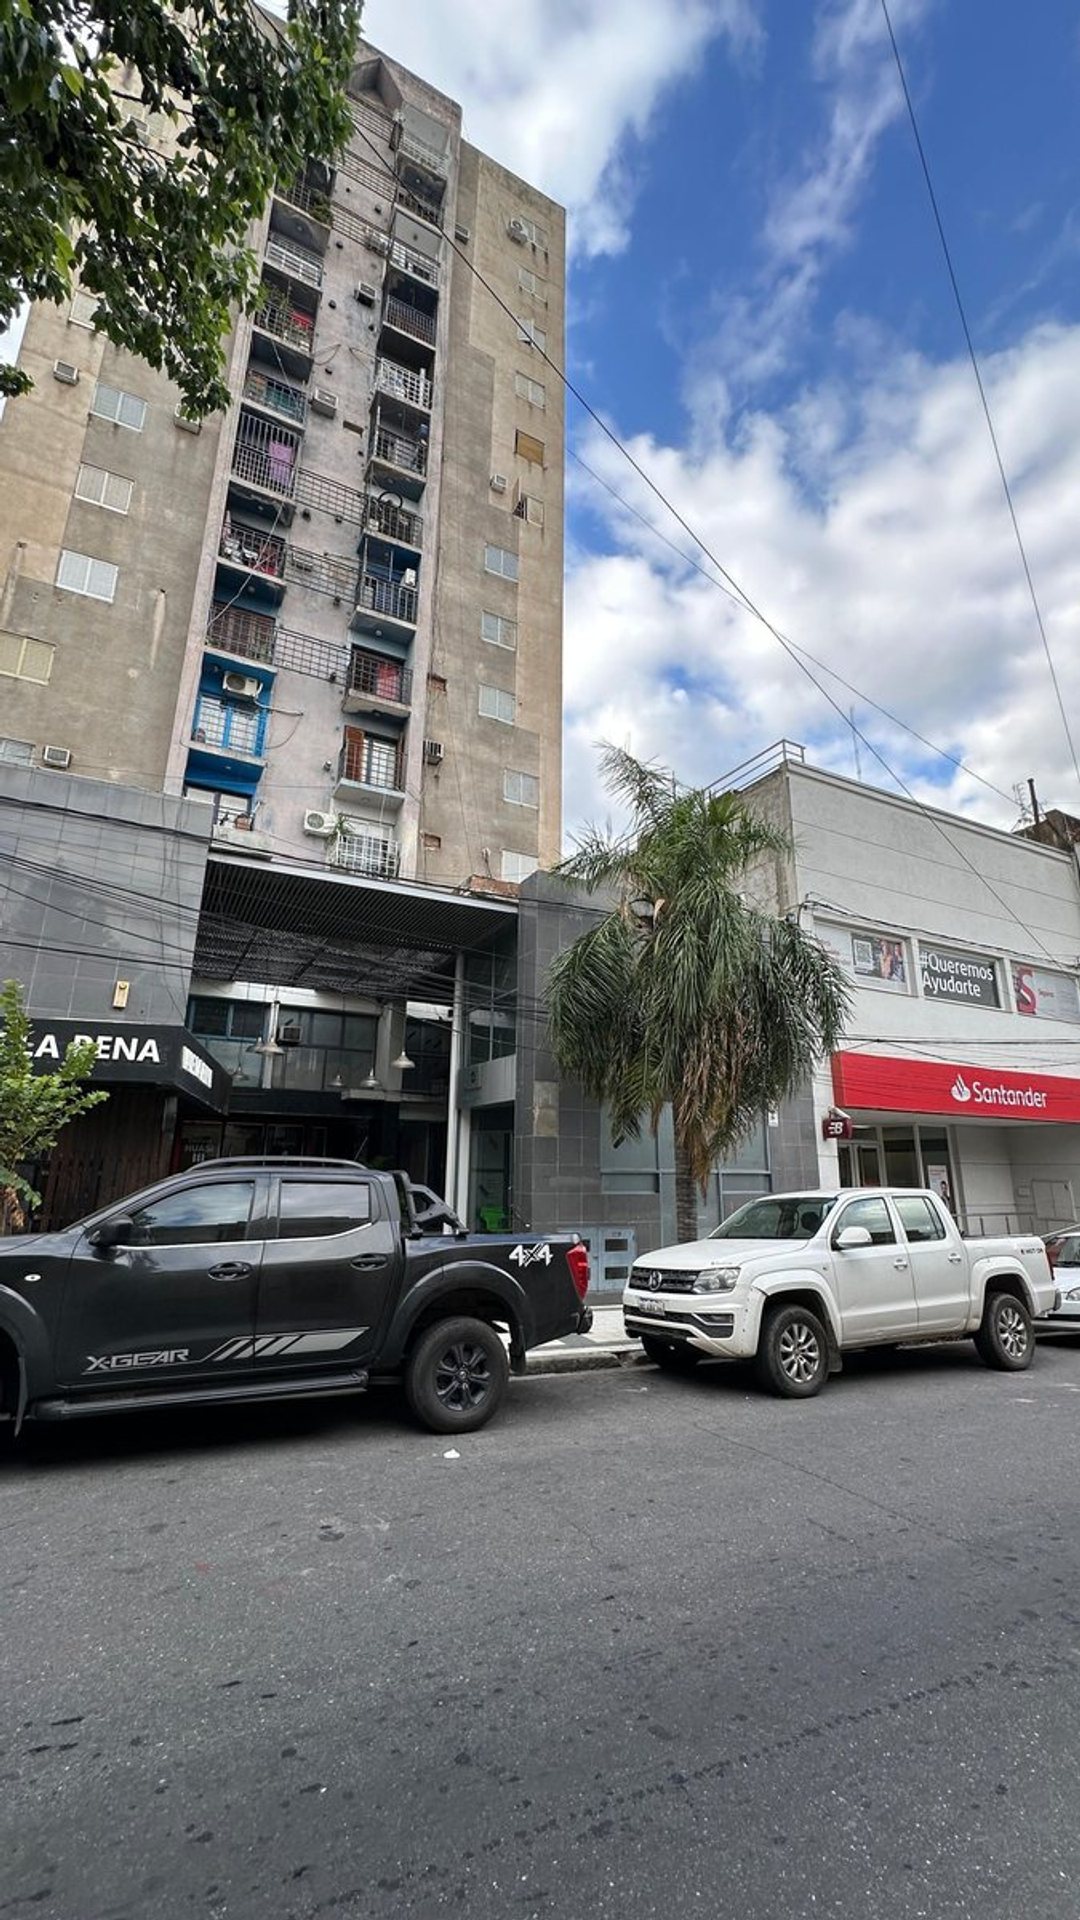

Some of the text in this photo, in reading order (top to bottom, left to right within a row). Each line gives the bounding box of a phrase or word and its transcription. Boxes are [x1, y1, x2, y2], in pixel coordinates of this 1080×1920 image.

[919, 951, 994, 981] #Queremos
[922, 971, 982, 998] Ayudarte
[972, 1081, 1048, 1108] Santander
[86, 1349, 190, 1371] X-GEAR
